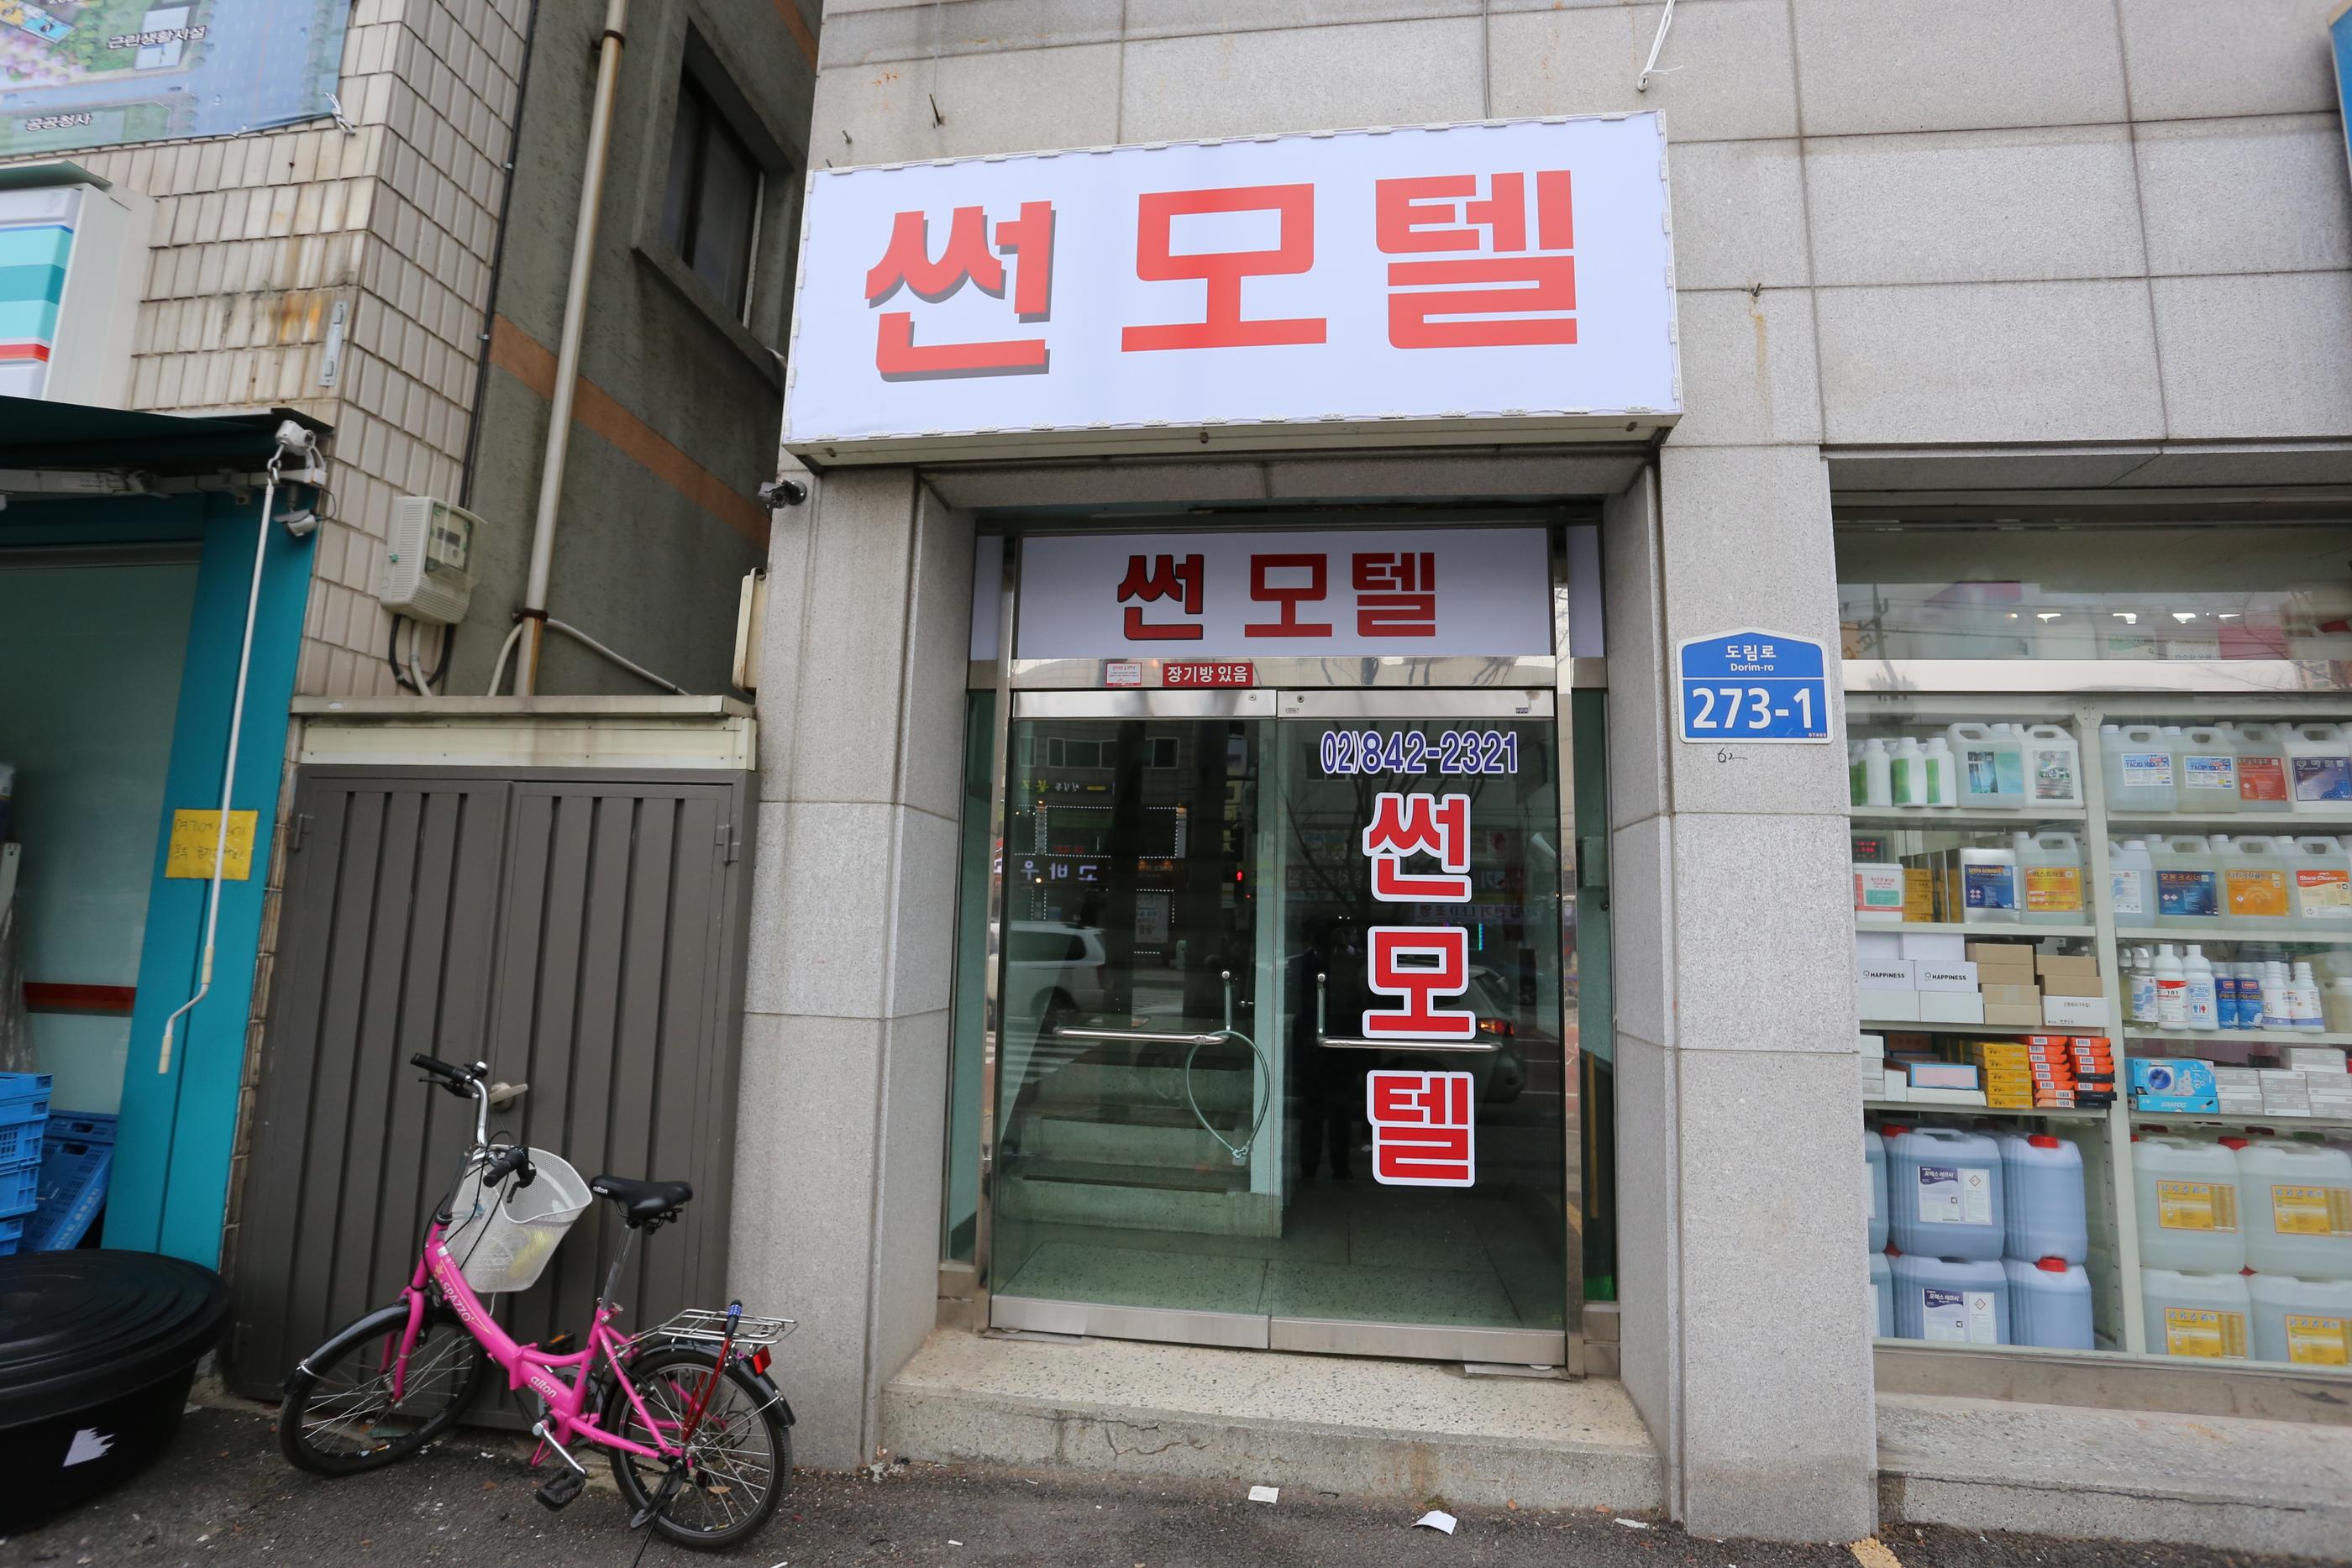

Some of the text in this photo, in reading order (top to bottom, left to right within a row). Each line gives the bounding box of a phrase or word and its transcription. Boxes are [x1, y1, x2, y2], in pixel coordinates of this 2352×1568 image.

[107, 26, 207, 50] 근린생활시설
[26, 113, 92, 132] 공공청사
[1725, 644, 1777, 662] 도림로
[1168, 666, 1248, 683] 장기방 있음
[1730, 663, 1774, 672] Dorim-ro
[1693, 687, 1813, 730] 273-1
[1320, 730, 1518, 774] 02)842-2321
[592, 1186, 608, 1194] alton
[443, 1282, 470, 1322] SPAZZO
[530, 1376, 558, 1398] alton
